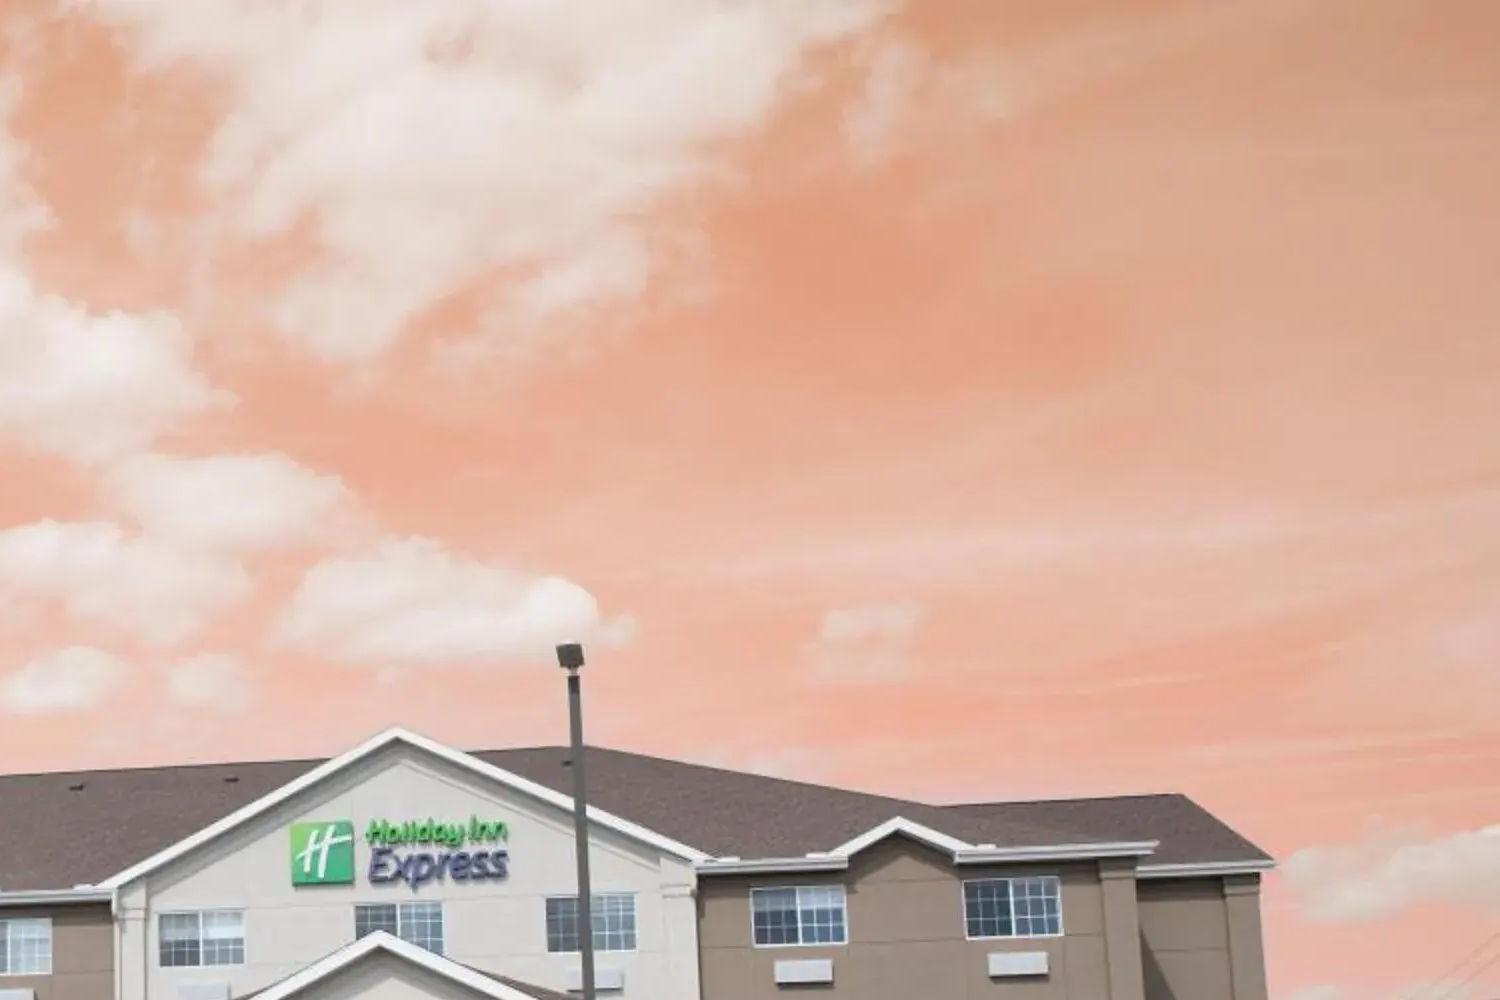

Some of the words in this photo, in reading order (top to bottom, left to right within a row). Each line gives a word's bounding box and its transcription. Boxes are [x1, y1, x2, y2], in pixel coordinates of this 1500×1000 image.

[365, 816, 466, 849] Holiday
[467, 813, 509, 845] Inn
[368, 847, 510, 893] Express
